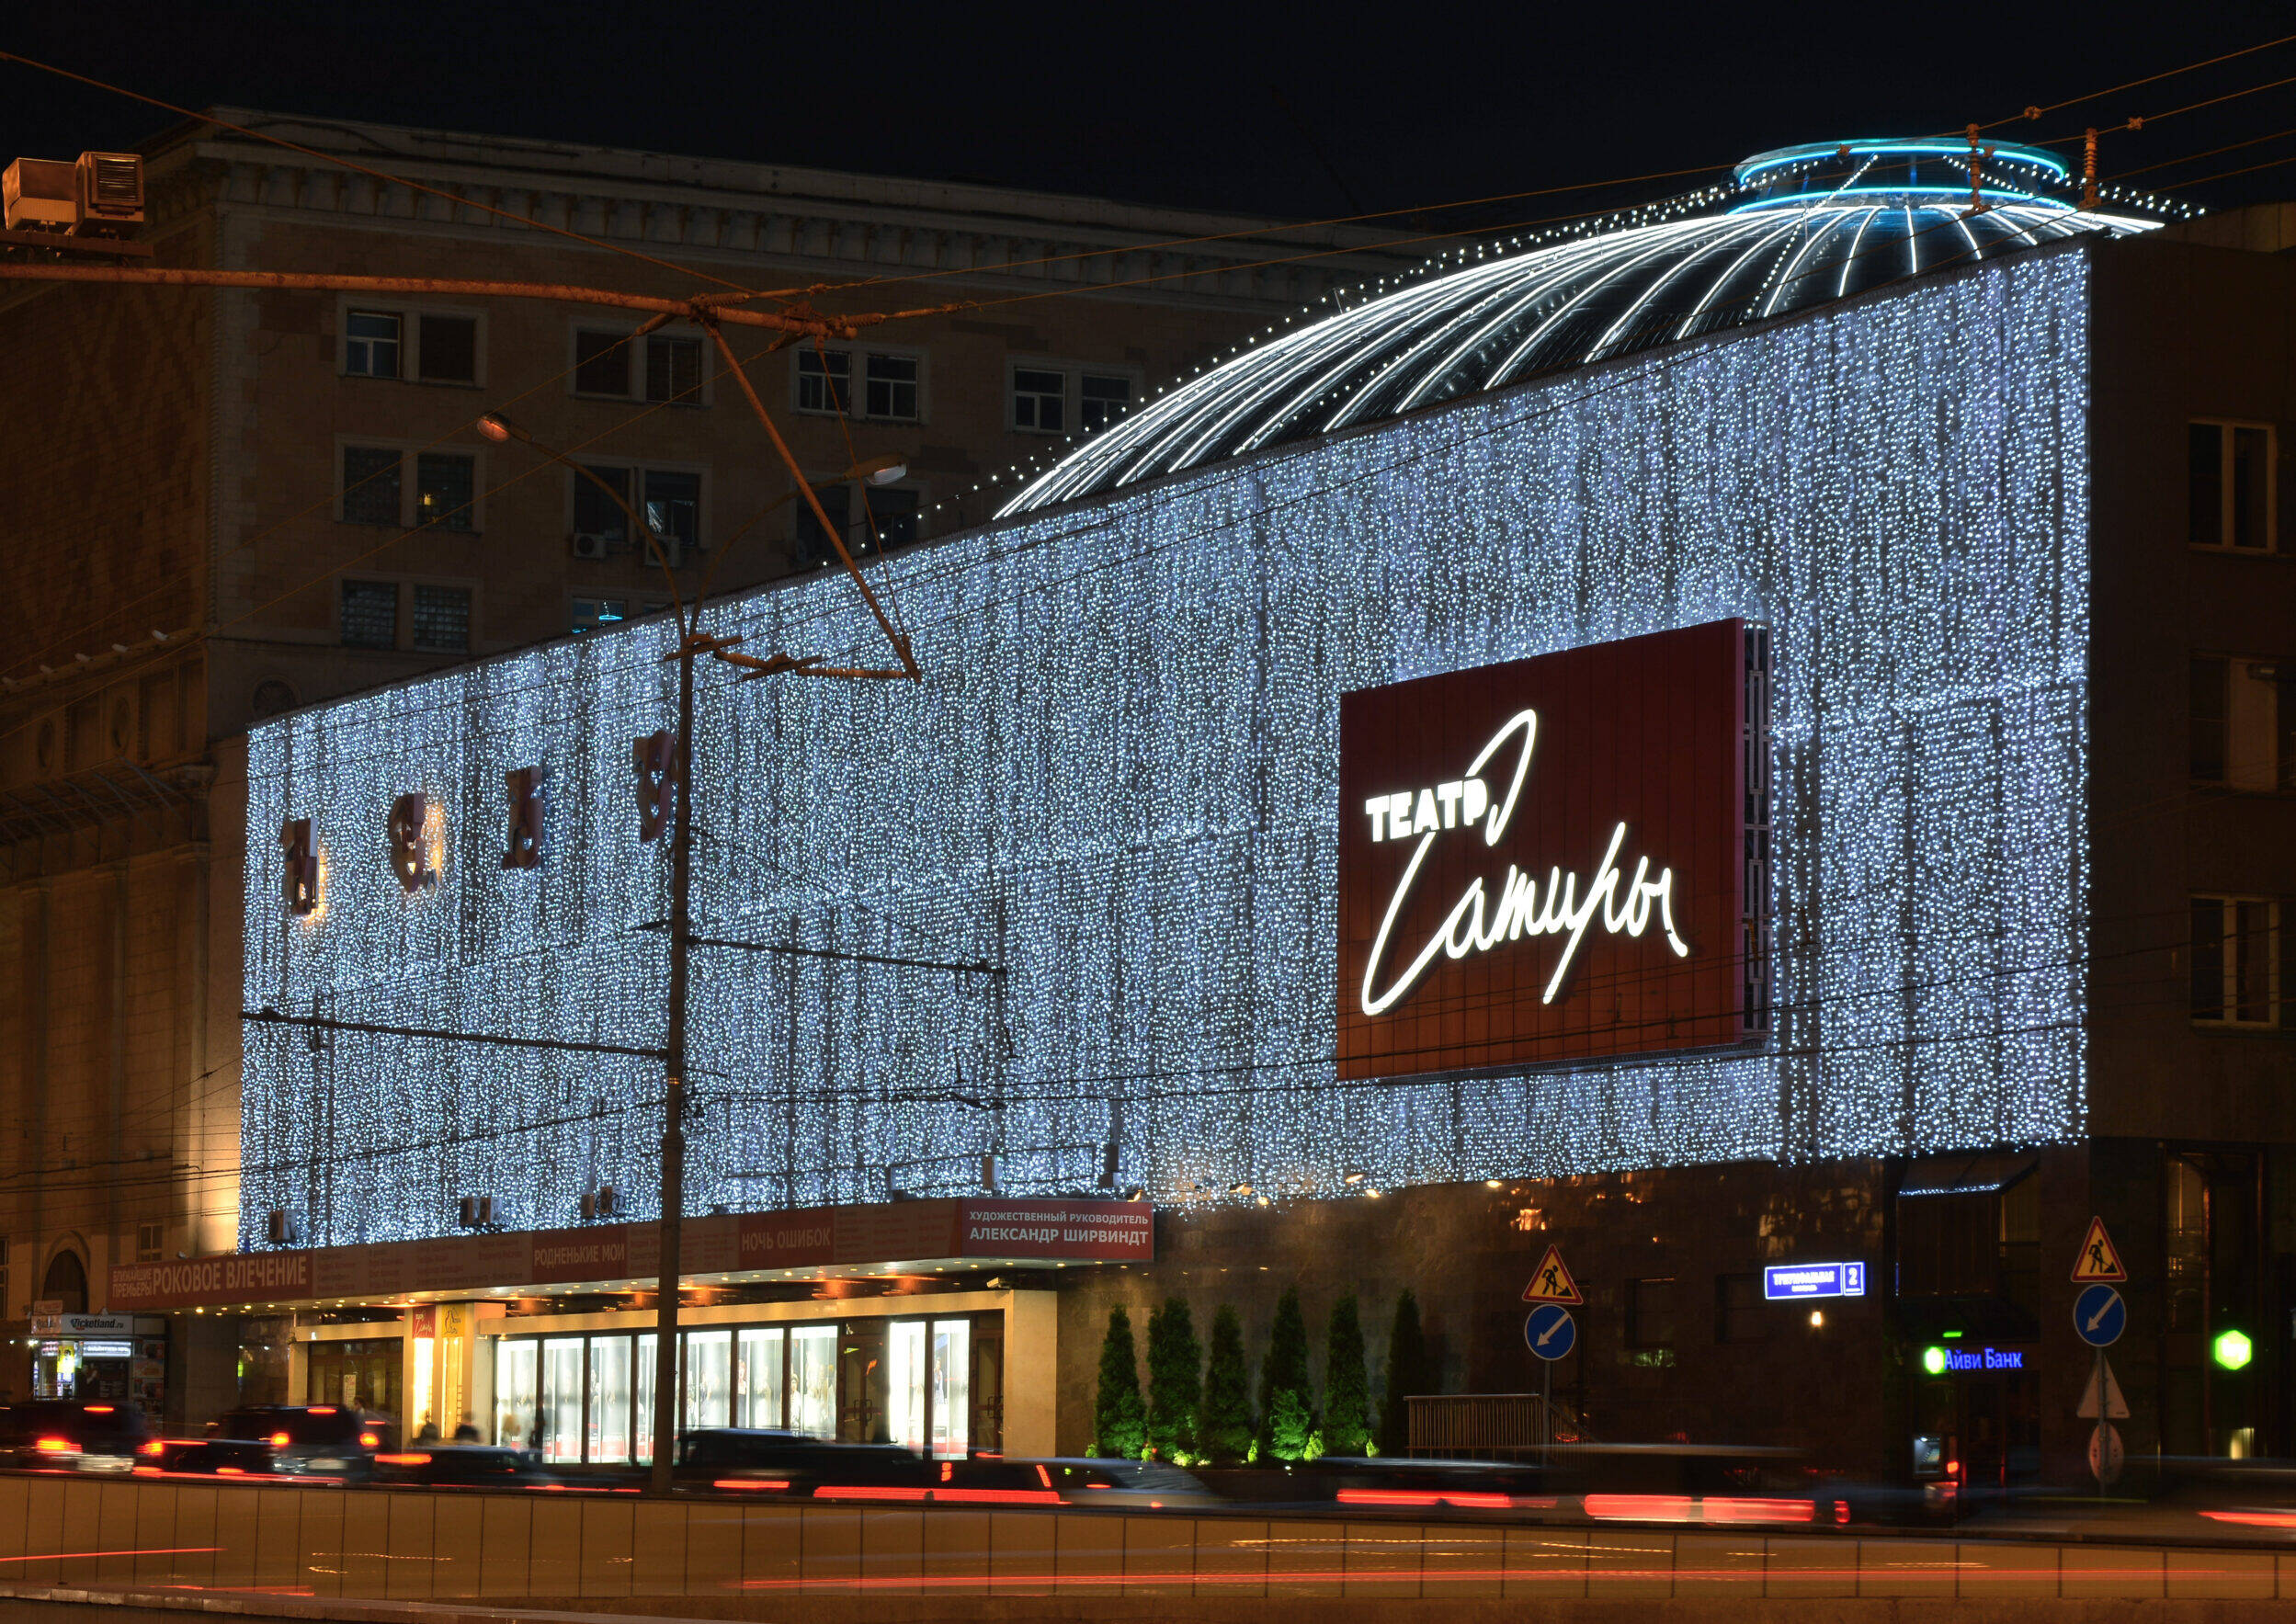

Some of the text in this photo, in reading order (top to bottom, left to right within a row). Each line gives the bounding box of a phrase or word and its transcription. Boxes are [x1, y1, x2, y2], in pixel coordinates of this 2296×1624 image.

[1365, 777, 1489, 843] ТЕАТР
[970, 1211, 1149, 1225] ХУДОЖЕСТВЕННЫЙ РУКОВОДИТЕЛЬ
[741, 1232, 774, 1252] НОЧЬ
[777, 1227, 831, 1248] ОШИБОК
[970, 1227, 1149, 1246] АЛЕКСАНДР ШИРВИНДТ
[533, 1245, 598, 1268] РОДНЕНЬКИЕ
[602, 1244, 625, 1263] МОИ
[112, 1267, 153, 1282] БЛИЖАЙШИЕ
[153, 1262, 222, 1296] РОКОВОЕ
[226, 1255, 307, 1289] ВЛЕЧЕНИЕ
[1848, 1267, 1858, 1286] 2
[112, 1281, 154, 1299] ПРЕМЬЕРЫ
[1944, 1347, 2023, 1370] Айви Банк
